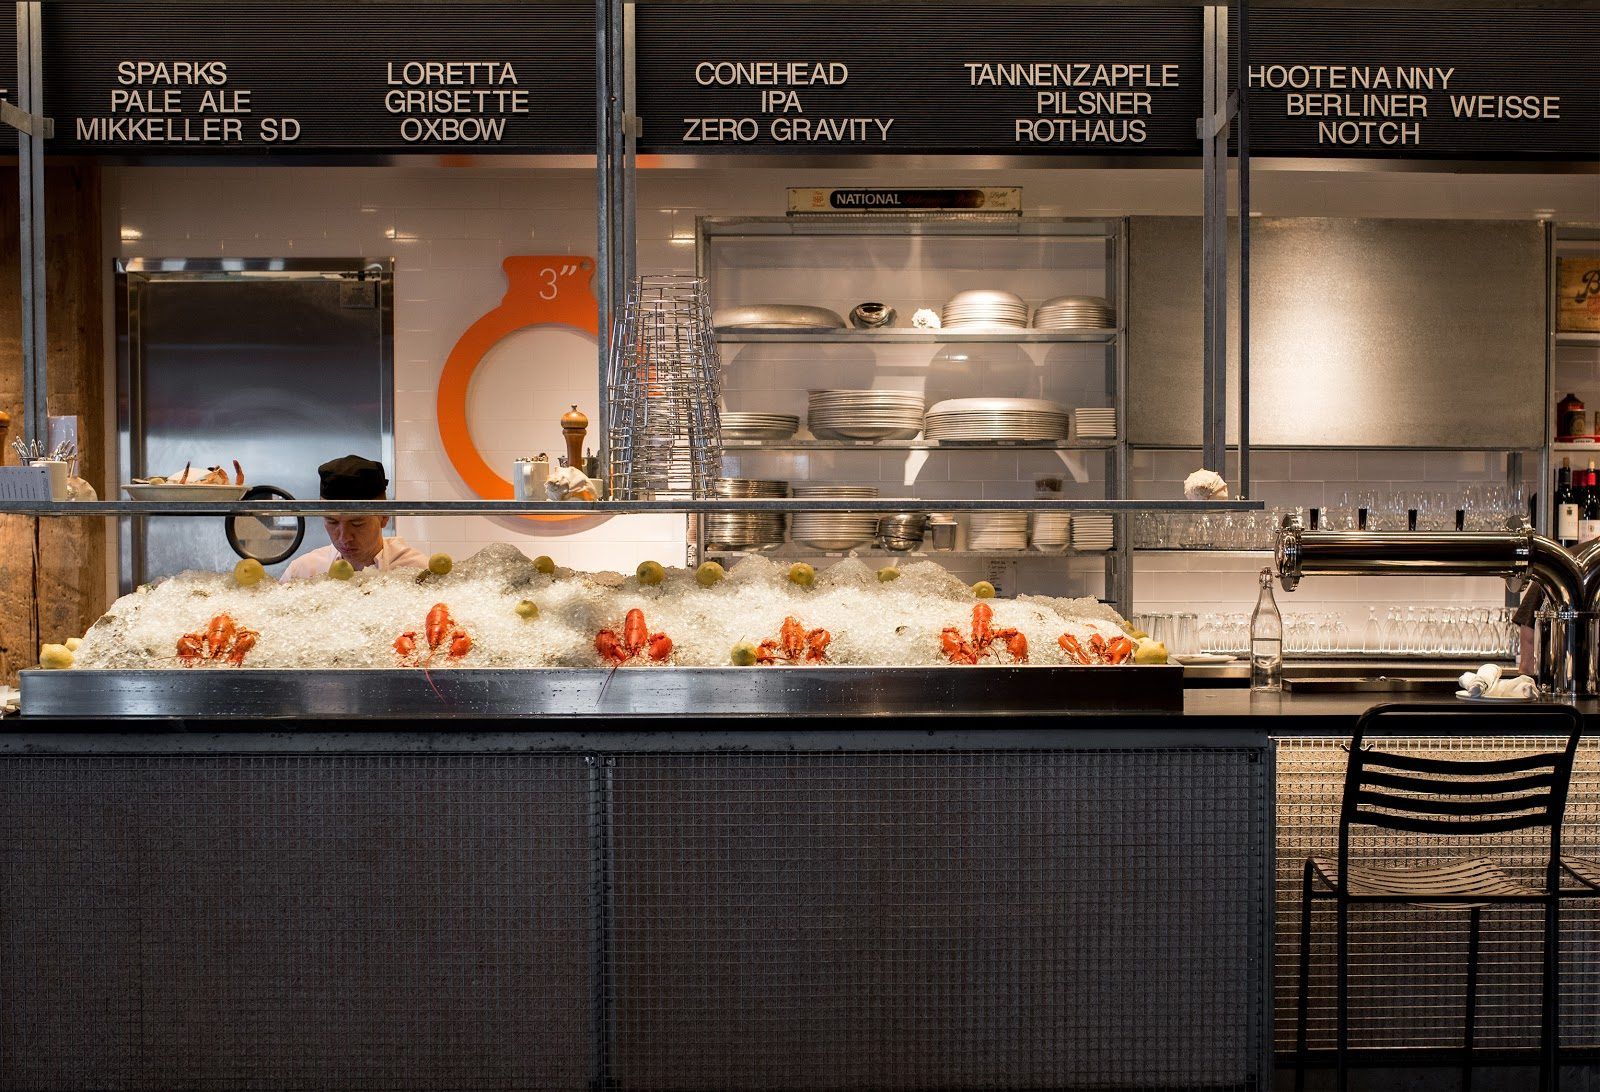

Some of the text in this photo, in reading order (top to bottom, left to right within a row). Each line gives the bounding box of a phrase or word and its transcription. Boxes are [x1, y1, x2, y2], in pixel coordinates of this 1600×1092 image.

[117, 61, 227, 85] SPARKS
[387, 61, 518, 85] LORETTA
[695, 61, 849, 86] CONEHEAD
[964, 63, 1179, 87] TANNENZAPFLE
[1248, 65, 1455, 90] HOOTENANNY
[111, 89, 252, 113] PALE ALE
[384, 89, 529, 114] GRISETTE
[761, 90, 803, 113] IPA
[1037, 91, 1152, 115] PILSNER
[1287, 93, 1560, 119] BERLINER WEISSE
[76, 117, 301, 142] MIKKELLER SD
[400, 117, 506, 141] OXBOW
[682, 117, 895, 141] ZERO GRAVITY
[1015, 118, 1147, 143] ROTHAUS
[1318, 121, 1420, 145] NOTCH
[835, 192, 901, 205] NATIONAL
